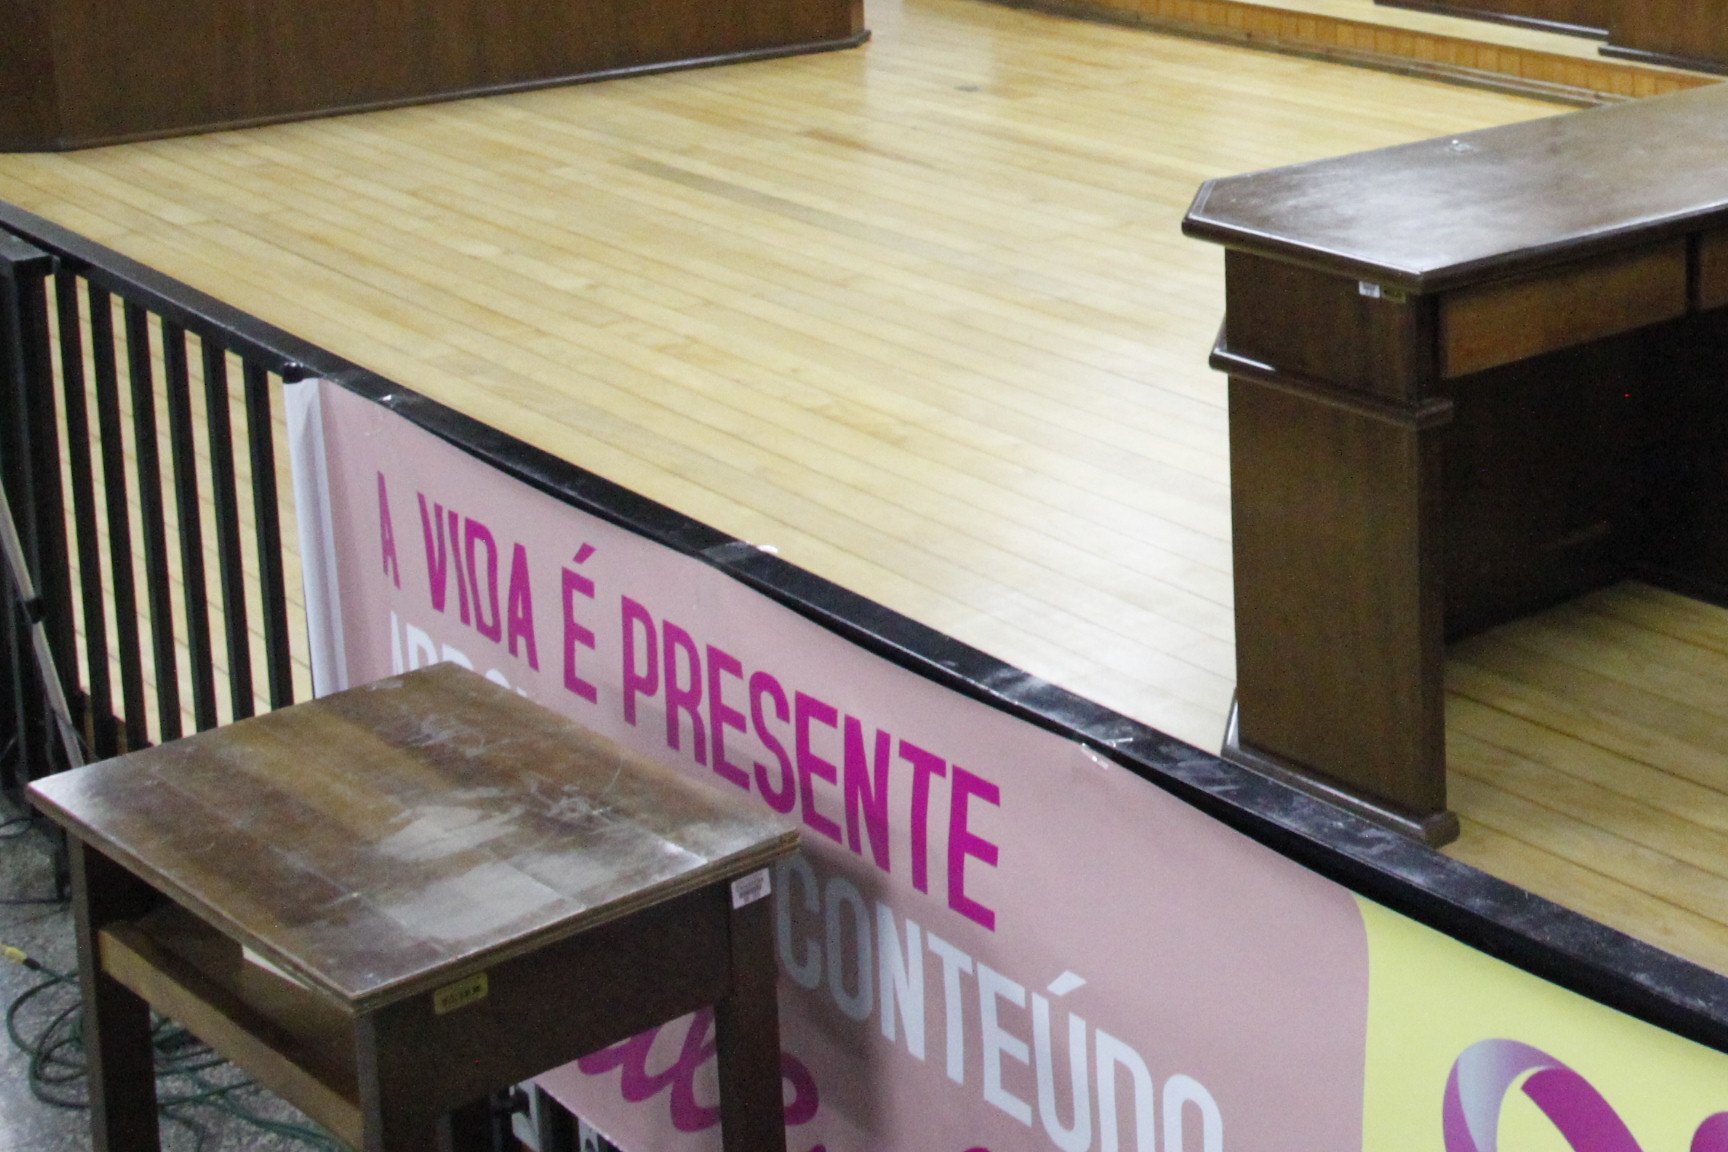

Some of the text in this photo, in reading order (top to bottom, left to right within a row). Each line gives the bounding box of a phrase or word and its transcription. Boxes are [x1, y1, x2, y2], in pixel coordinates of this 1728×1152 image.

[377, 470, 401, 590] A
[417, 491, 540, 673] VIDA
[561, 542, 598, 706] É
[621, 594, 1001, 933] PRESENTE
